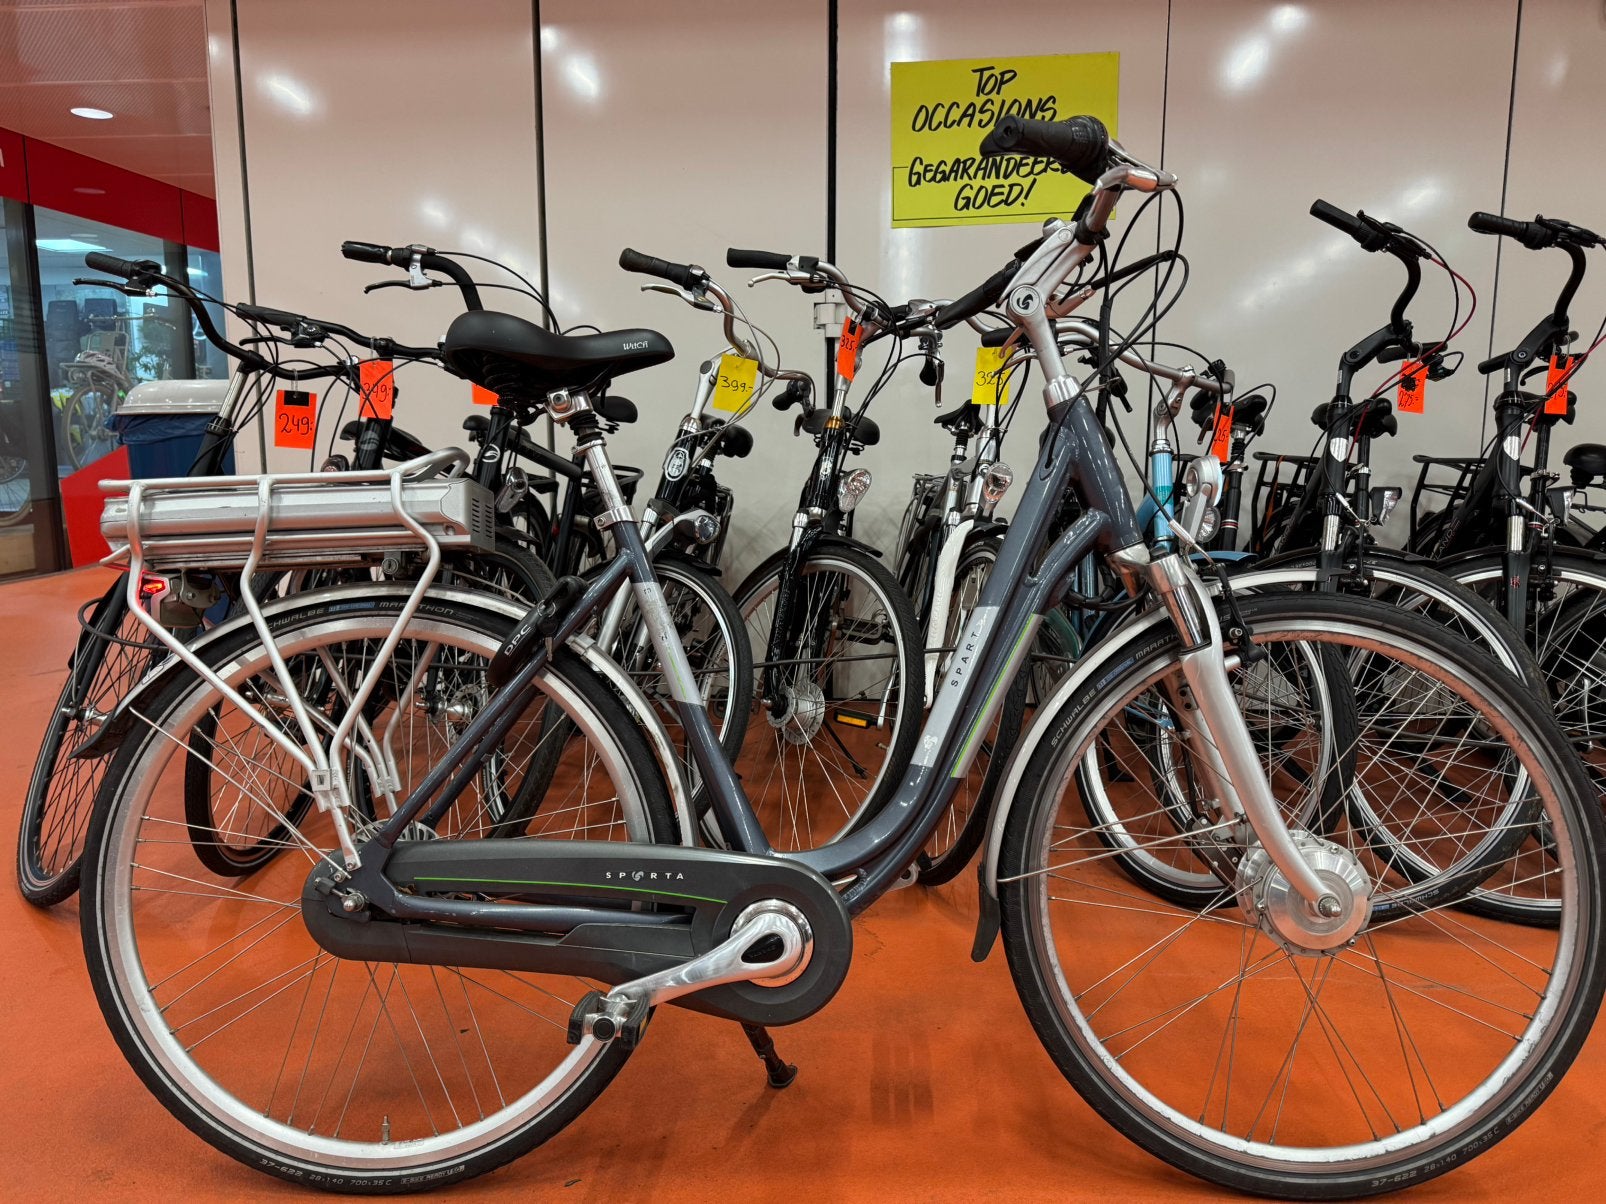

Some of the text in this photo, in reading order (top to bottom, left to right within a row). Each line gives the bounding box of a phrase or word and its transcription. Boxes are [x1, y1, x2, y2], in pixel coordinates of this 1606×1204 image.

[971, 65, 1018, 97] TOP
[911, 95, 1058, 132] OCCASIONS
[907, 156, 1071, 188] GEGARANDEER
[953, 178, 1037, 212] GOED!
[267, 607, 325, 630] CHWALBE
[378, 600, 455, 615] MARTHON
[504, 624, 531, 656] DPC
[951, 629, 980, 688] SPART
[1051, 633, 1179, 748] SCHWALBE MARATH
[258, 1157, 304, 1178] 37-622
[1371, 1169, 1418, 1188] 37-622
